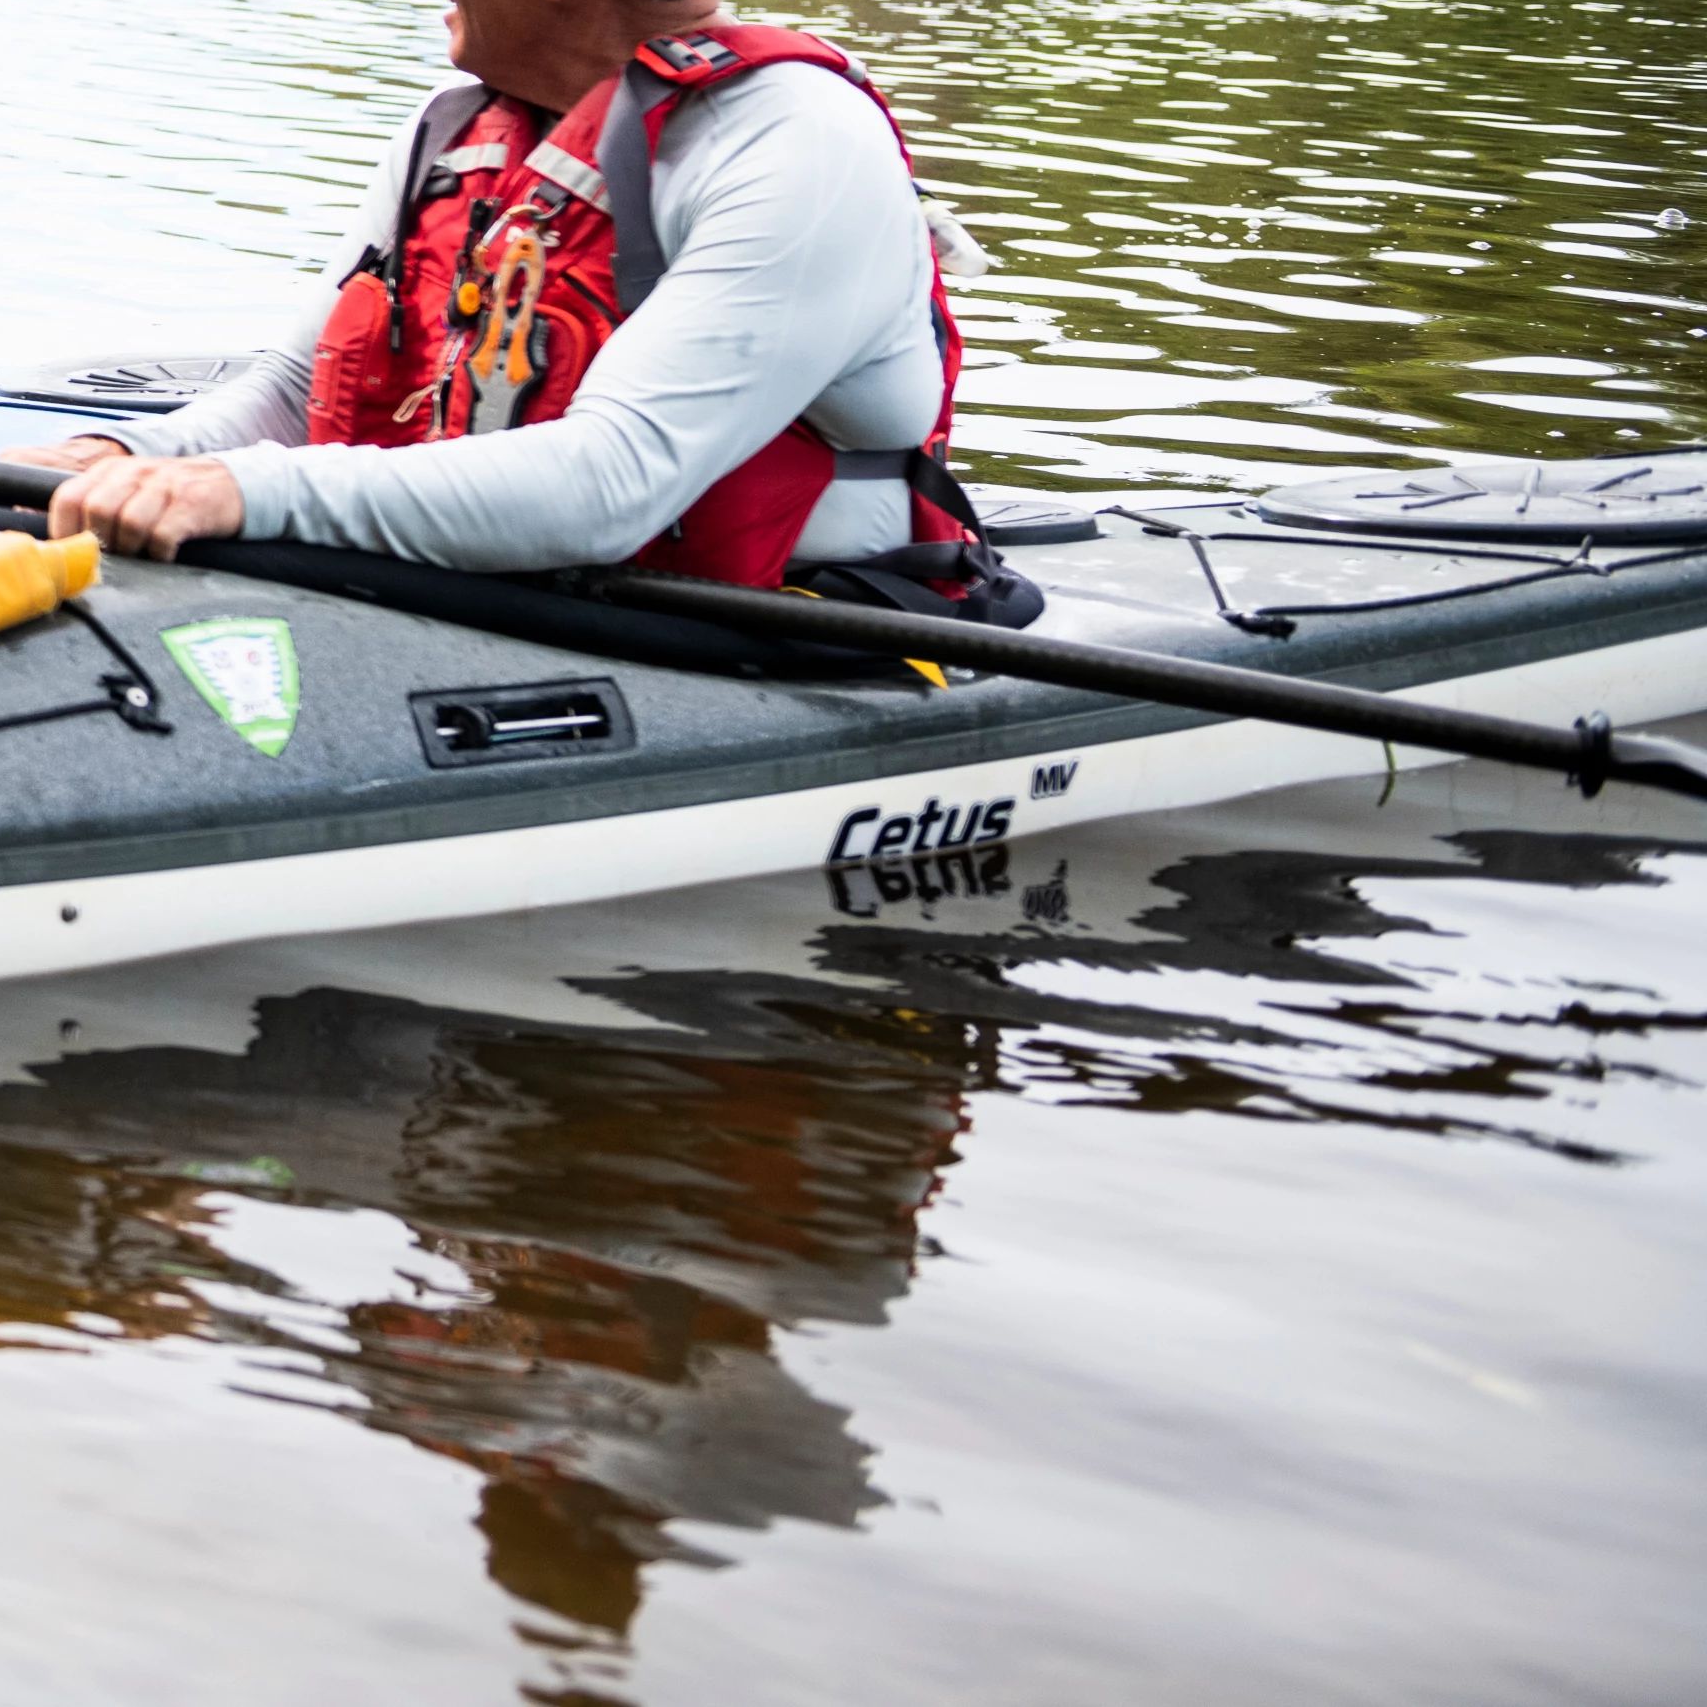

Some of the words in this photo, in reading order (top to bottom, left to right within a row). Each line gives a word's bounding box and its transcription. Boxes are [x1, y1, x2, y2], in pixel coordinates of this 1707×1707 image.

[505, 225, 561, 248] NS
[827, 796, 1016, 863] Cetus
[1032, 758, 1079, 799] MV
